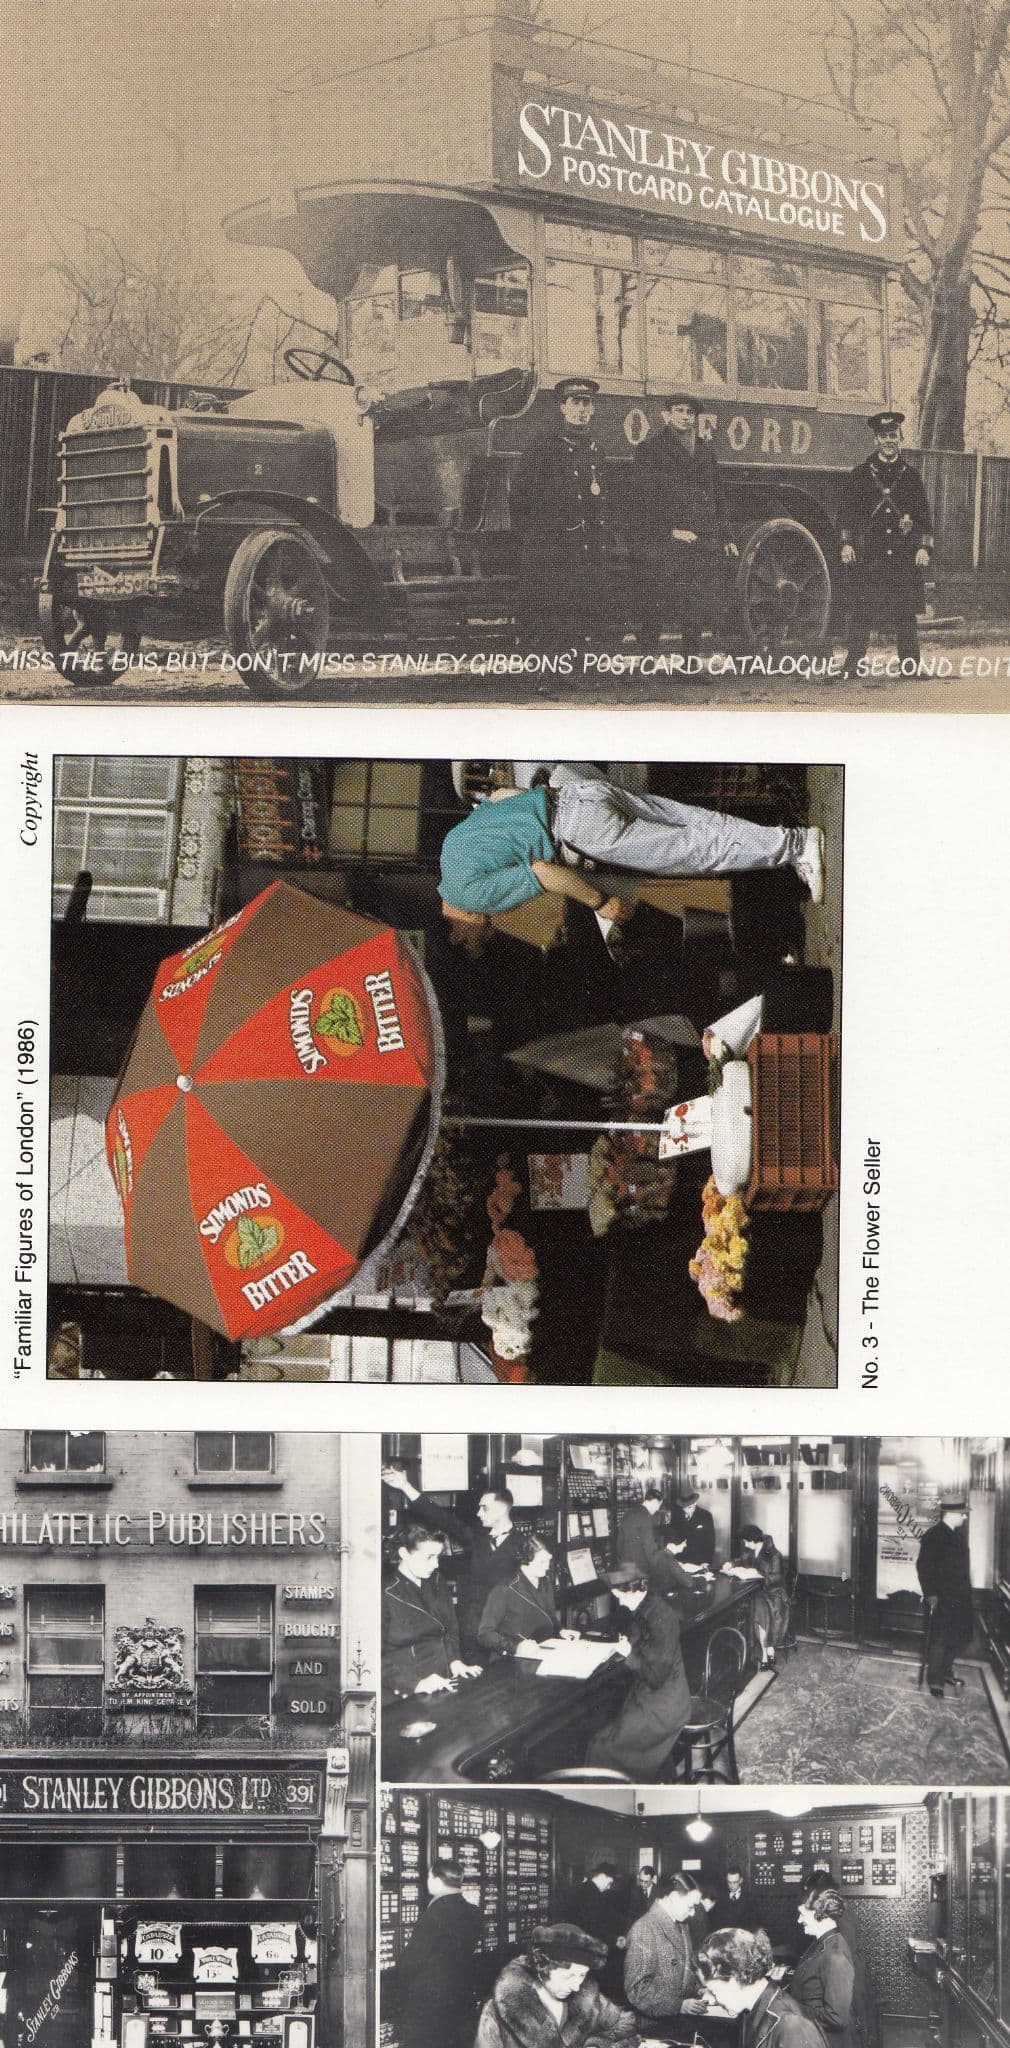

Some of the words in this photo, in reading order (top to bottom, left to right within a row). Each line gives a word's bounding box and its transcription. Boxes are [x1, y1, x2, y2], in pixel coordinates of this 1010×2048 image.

[518, 102, 714, 179] STANLEY
[721, 149, 888, 243] GIBBONS
[562, 155, 694, 206] POSTCARD
[700, 185, 845, 236] CATALOGUE
[623, 407, 813, 455] OFORD
[19, 751, 42, 847] Copyright
[290, 987, 328, 1074] SIMONDS
[364, 970, 405, 1053] BITTER
[17, 1020, 40, 1085] (1986)
[16, 1182, 34, 1202] of
[863, 1137, 881, 1196] Seller
[199, 1182, 272, 1244] SIMONDS
[863, 1201, 881, 1269] Flower
[15, 1209, 37, 1283] Figures
[241, 1250, 318, 1311] BITTER
[862, 1276, 880, 1316] The
[862, 1336, 879, 1349] 3
[862, 1356, 880, 1389] No.
[149, 1509, 326, 1545] PUBLISHERS
[285, 1585, 335, 1599] STAMPS
[284, 1623, 338, 1637] BOUGHT
[294, 1661, 323, 1675] AND
[290, 1700, 327, 1714] SOLD
[22, 1775, 124, 1809] STANLEY
[129, 1775, 234, 1810] GIBBONS
[285, 1785, 314, 1804] 391
[26, 1994, 53, 2043] STANLEY
[49, 1951, 79, 2000] GIBBONS
